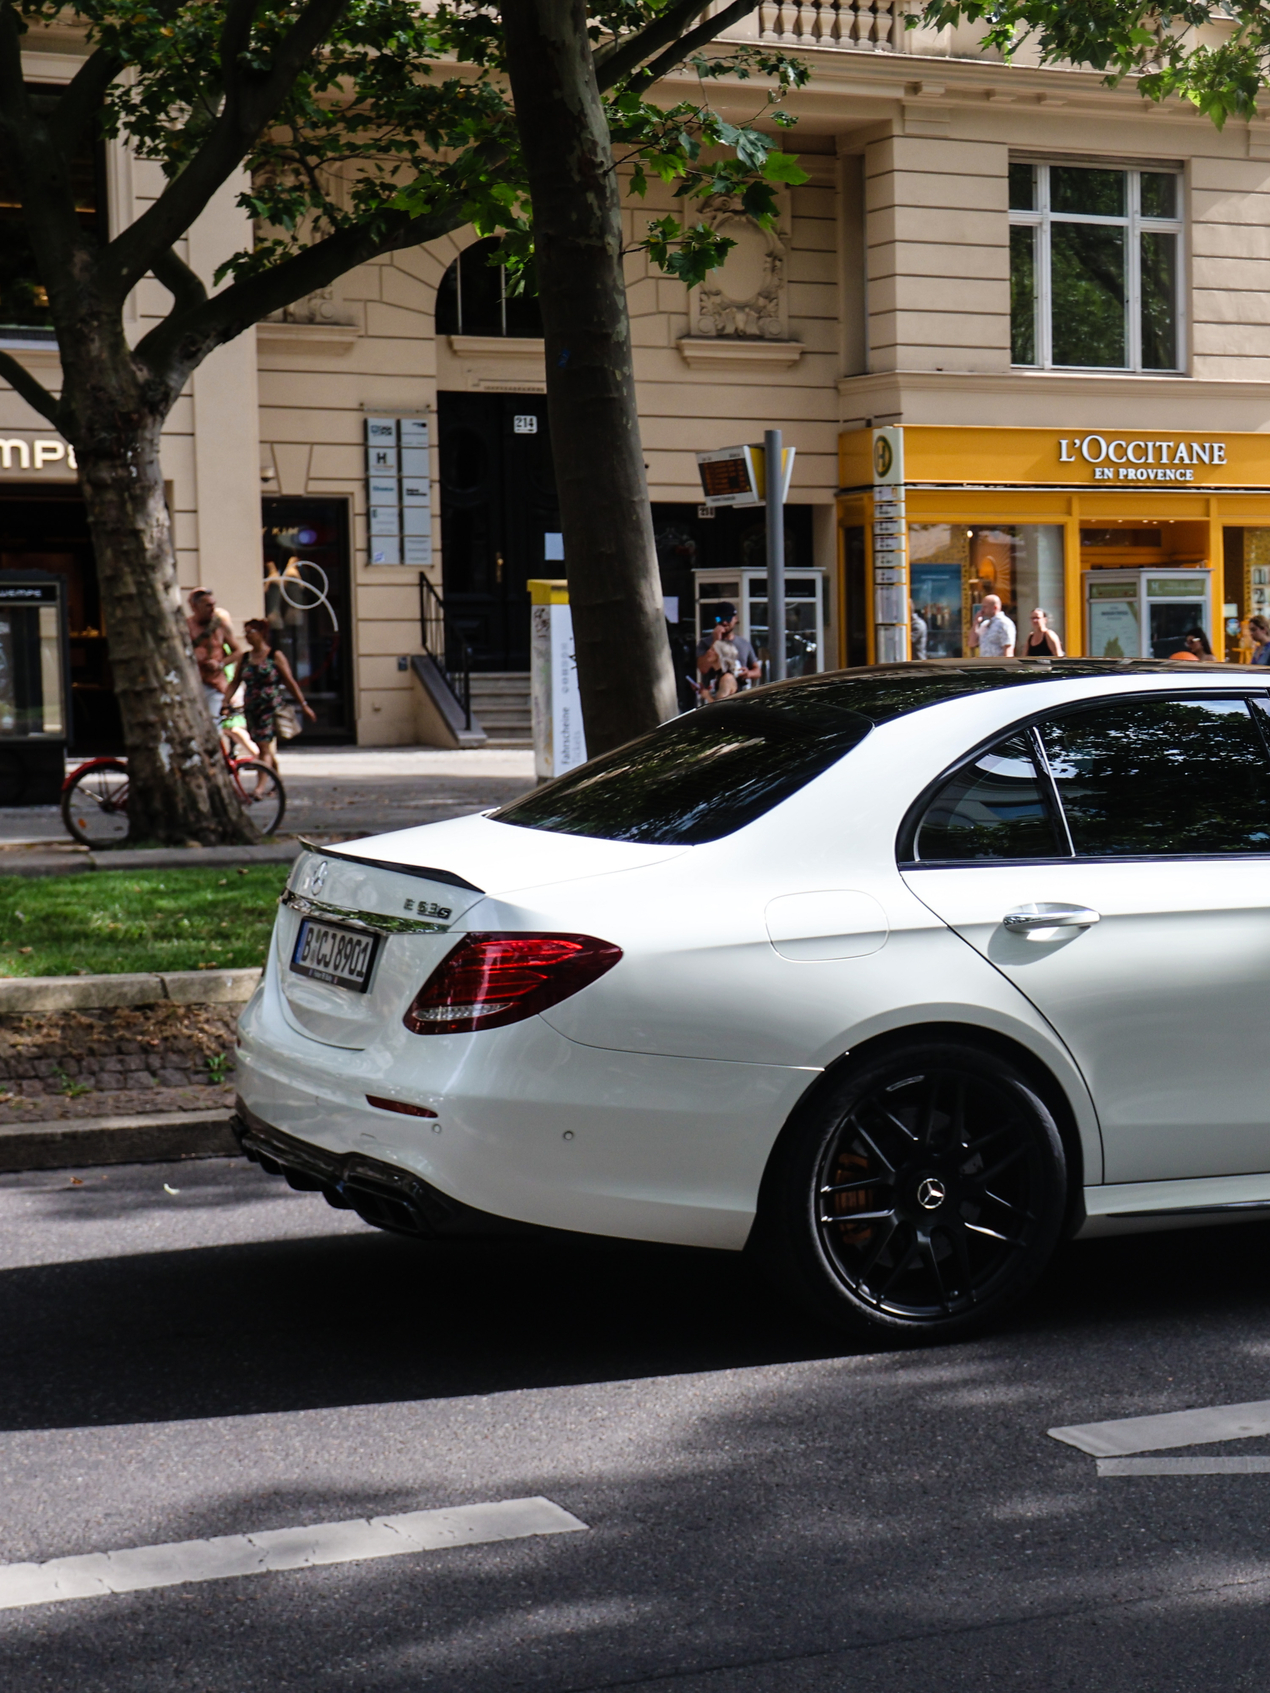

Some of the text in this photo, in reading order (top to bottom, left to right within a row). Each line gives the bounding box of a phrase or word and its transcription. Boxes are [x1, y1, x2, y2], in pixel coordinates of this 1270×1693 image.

[515, 417, 534, 428] 214
[1094, 467, 1194, 481] EN PROVENCE
[301, 926, 315, 962] B
